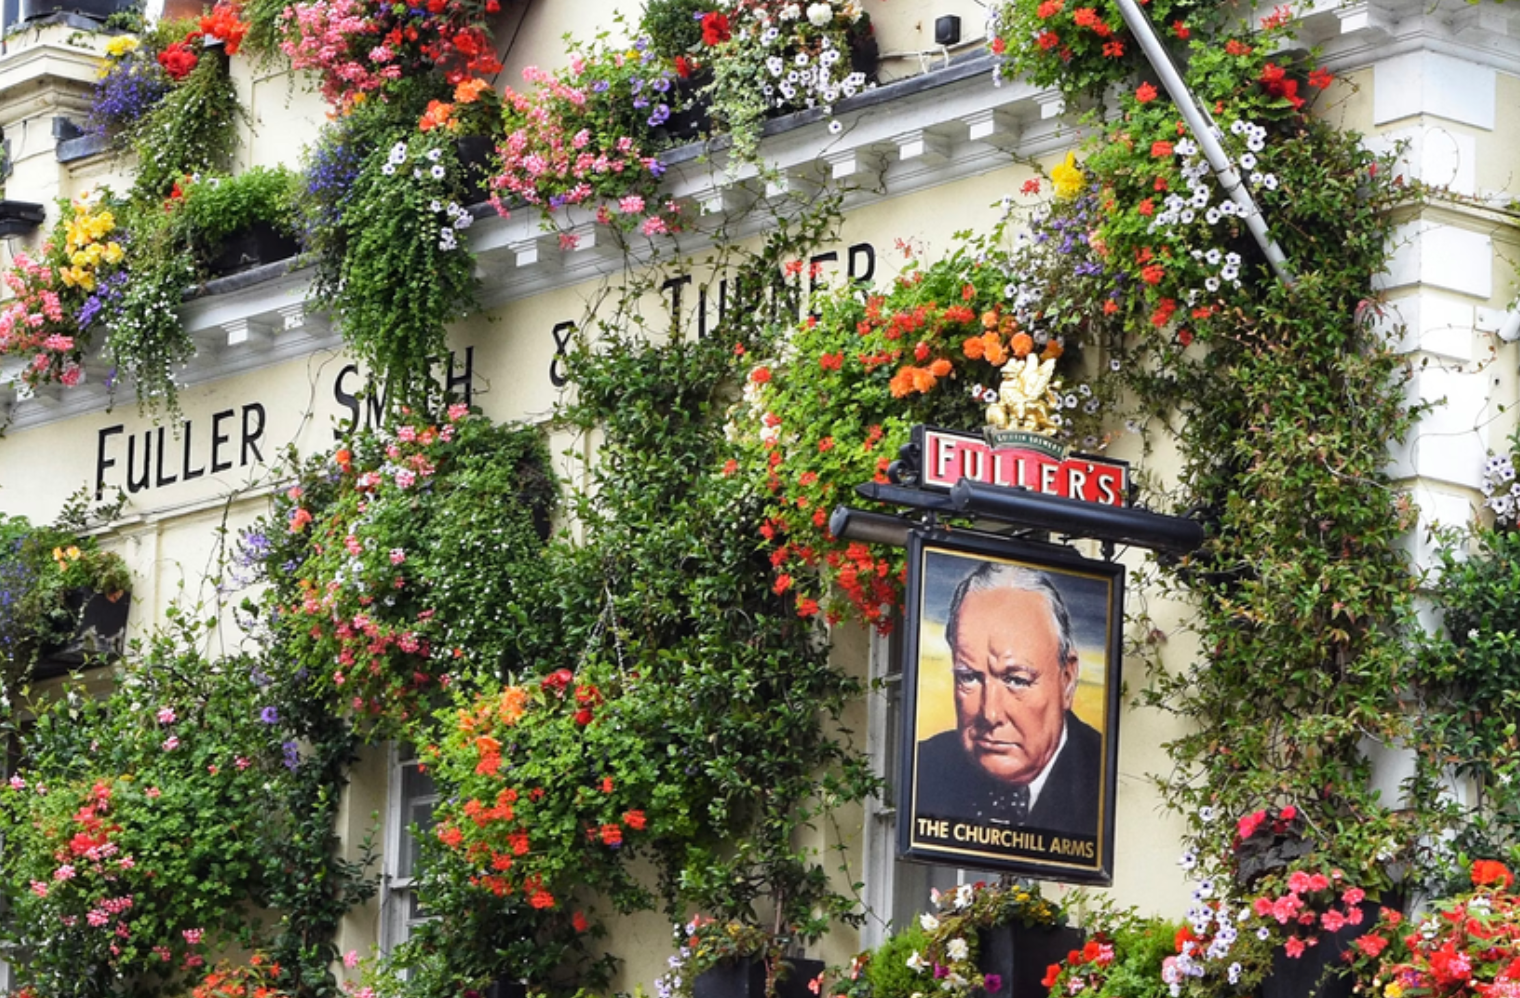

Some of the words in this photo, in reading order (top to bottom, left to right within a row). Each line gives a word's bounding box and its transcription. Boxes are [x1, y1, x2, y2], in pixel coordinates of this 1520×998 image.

[95, 402, 266, 502] FULLER
[937, 438, 1116, 506] FULLER'S
[917, 817, 950, 839] THE
[952, 823, 1046, 852] CHURCHILL
[1049, 836, 1095, 859] ARMS
